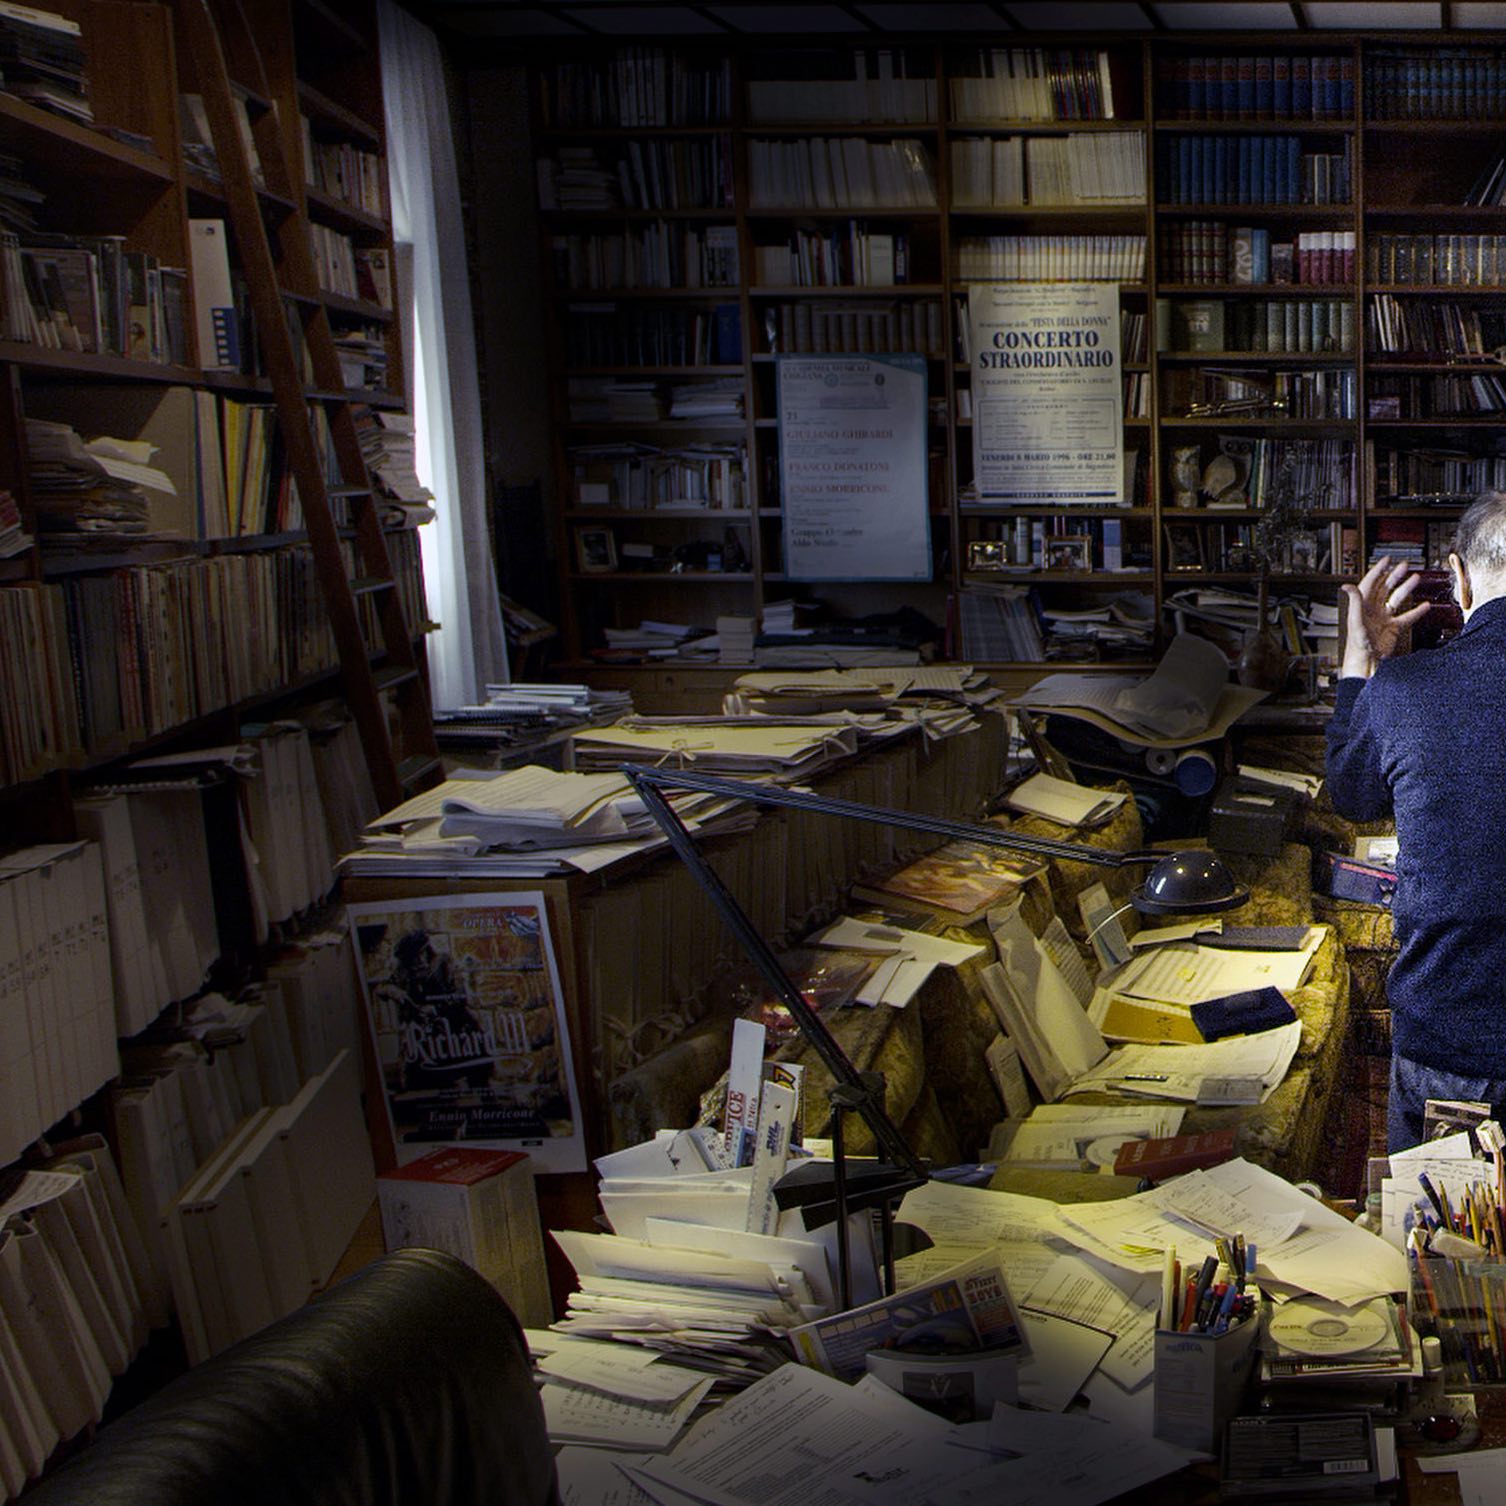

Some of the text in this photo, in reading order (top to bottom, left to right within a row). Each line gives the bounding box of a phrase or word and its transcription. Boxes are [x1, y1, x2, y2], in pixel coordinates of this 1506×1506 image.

[993, 331, 1099, 348] CONCERTO
[979, 351, 1114, 368] STRAORDINARIO
[404, 1014, 498, 1064] Richard
[470, 1107, 535, 1120] Morricone
